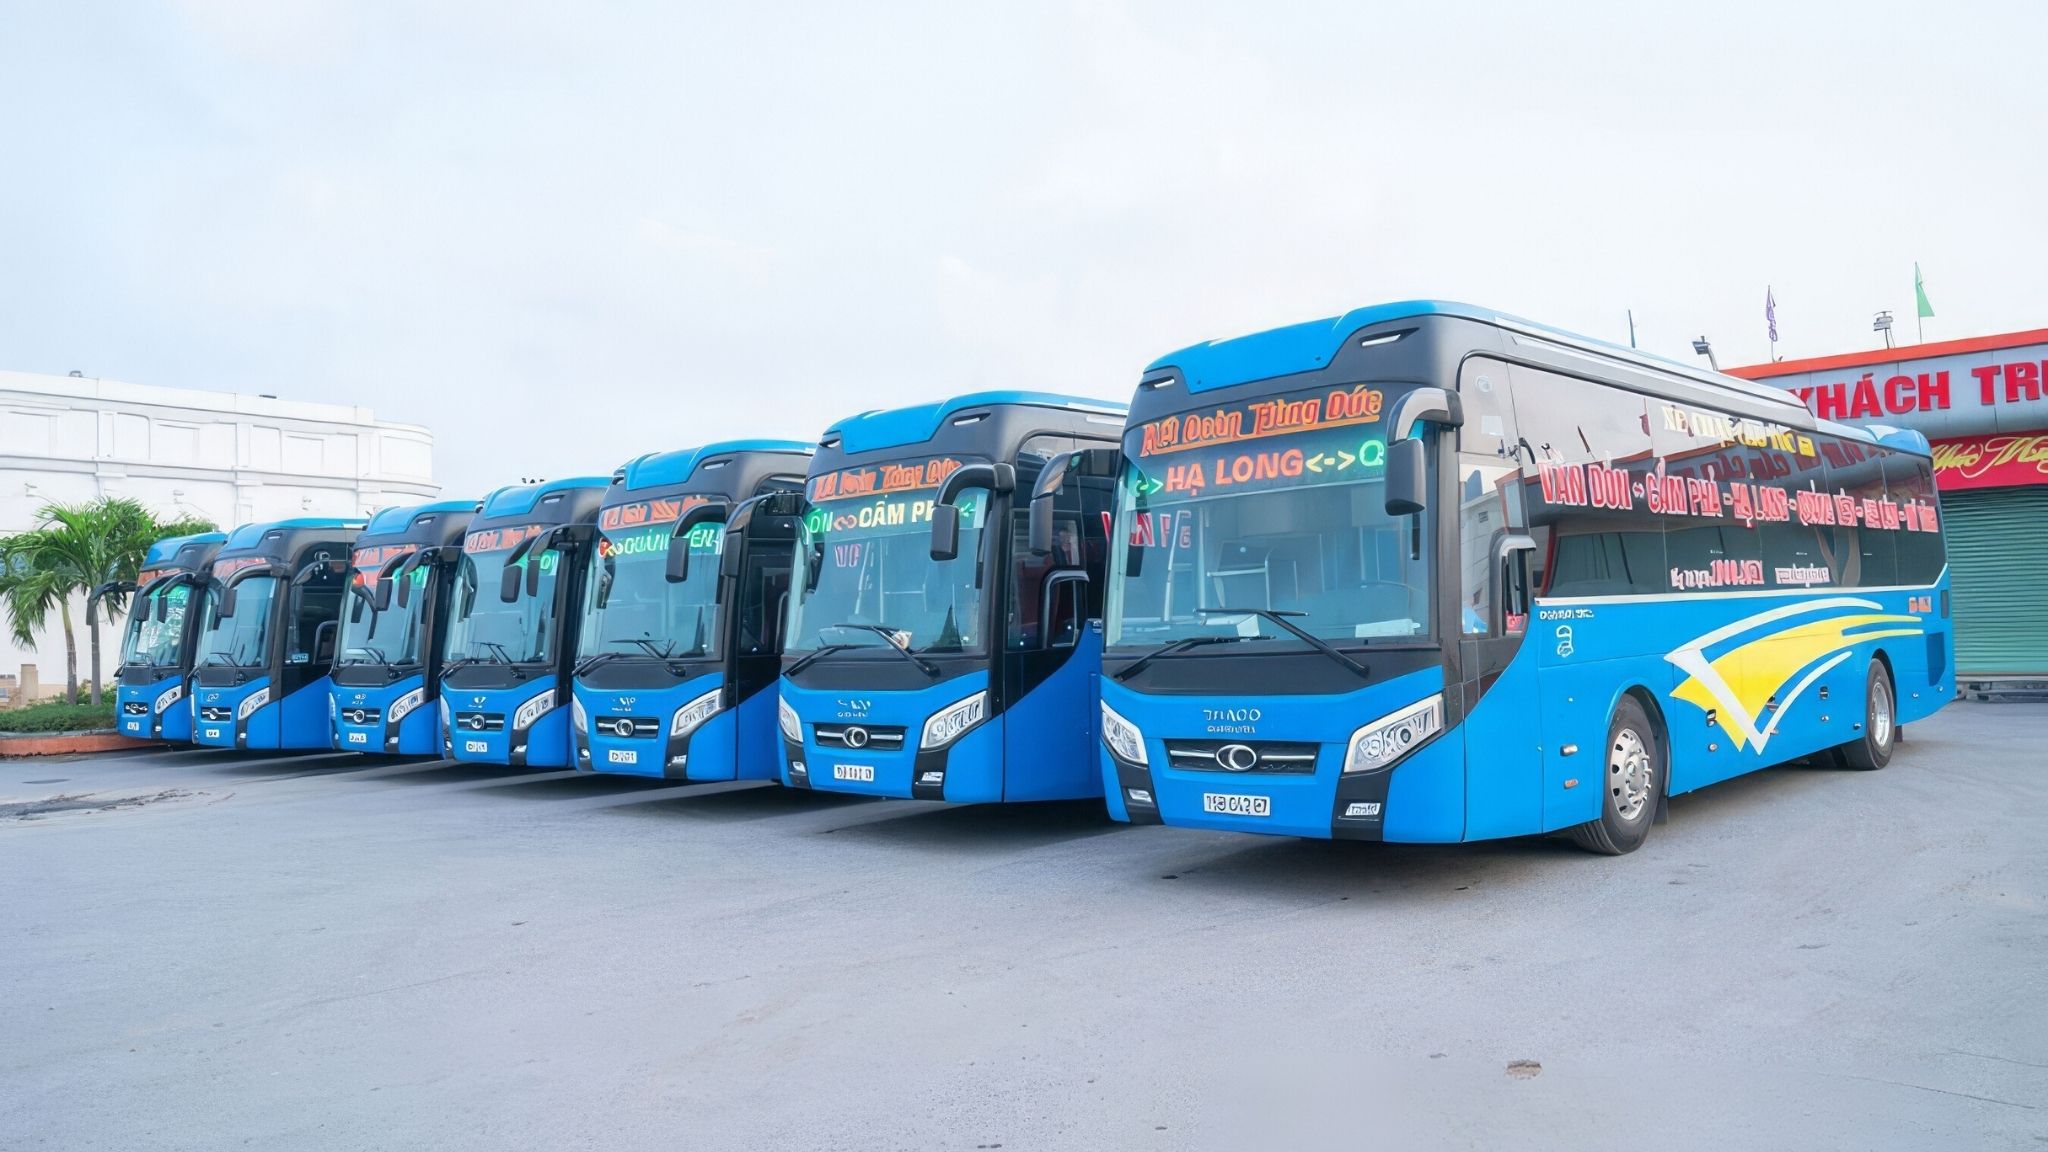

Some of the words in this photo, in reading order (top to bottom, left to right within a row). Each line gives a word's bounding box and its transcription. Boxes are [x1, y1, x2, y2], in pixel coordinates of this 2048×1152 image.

[1971, 359, 2048, 406] TR
[1165, 463, 1206, 496] HẠ
[1216, 448, 1304, 486] LONG
